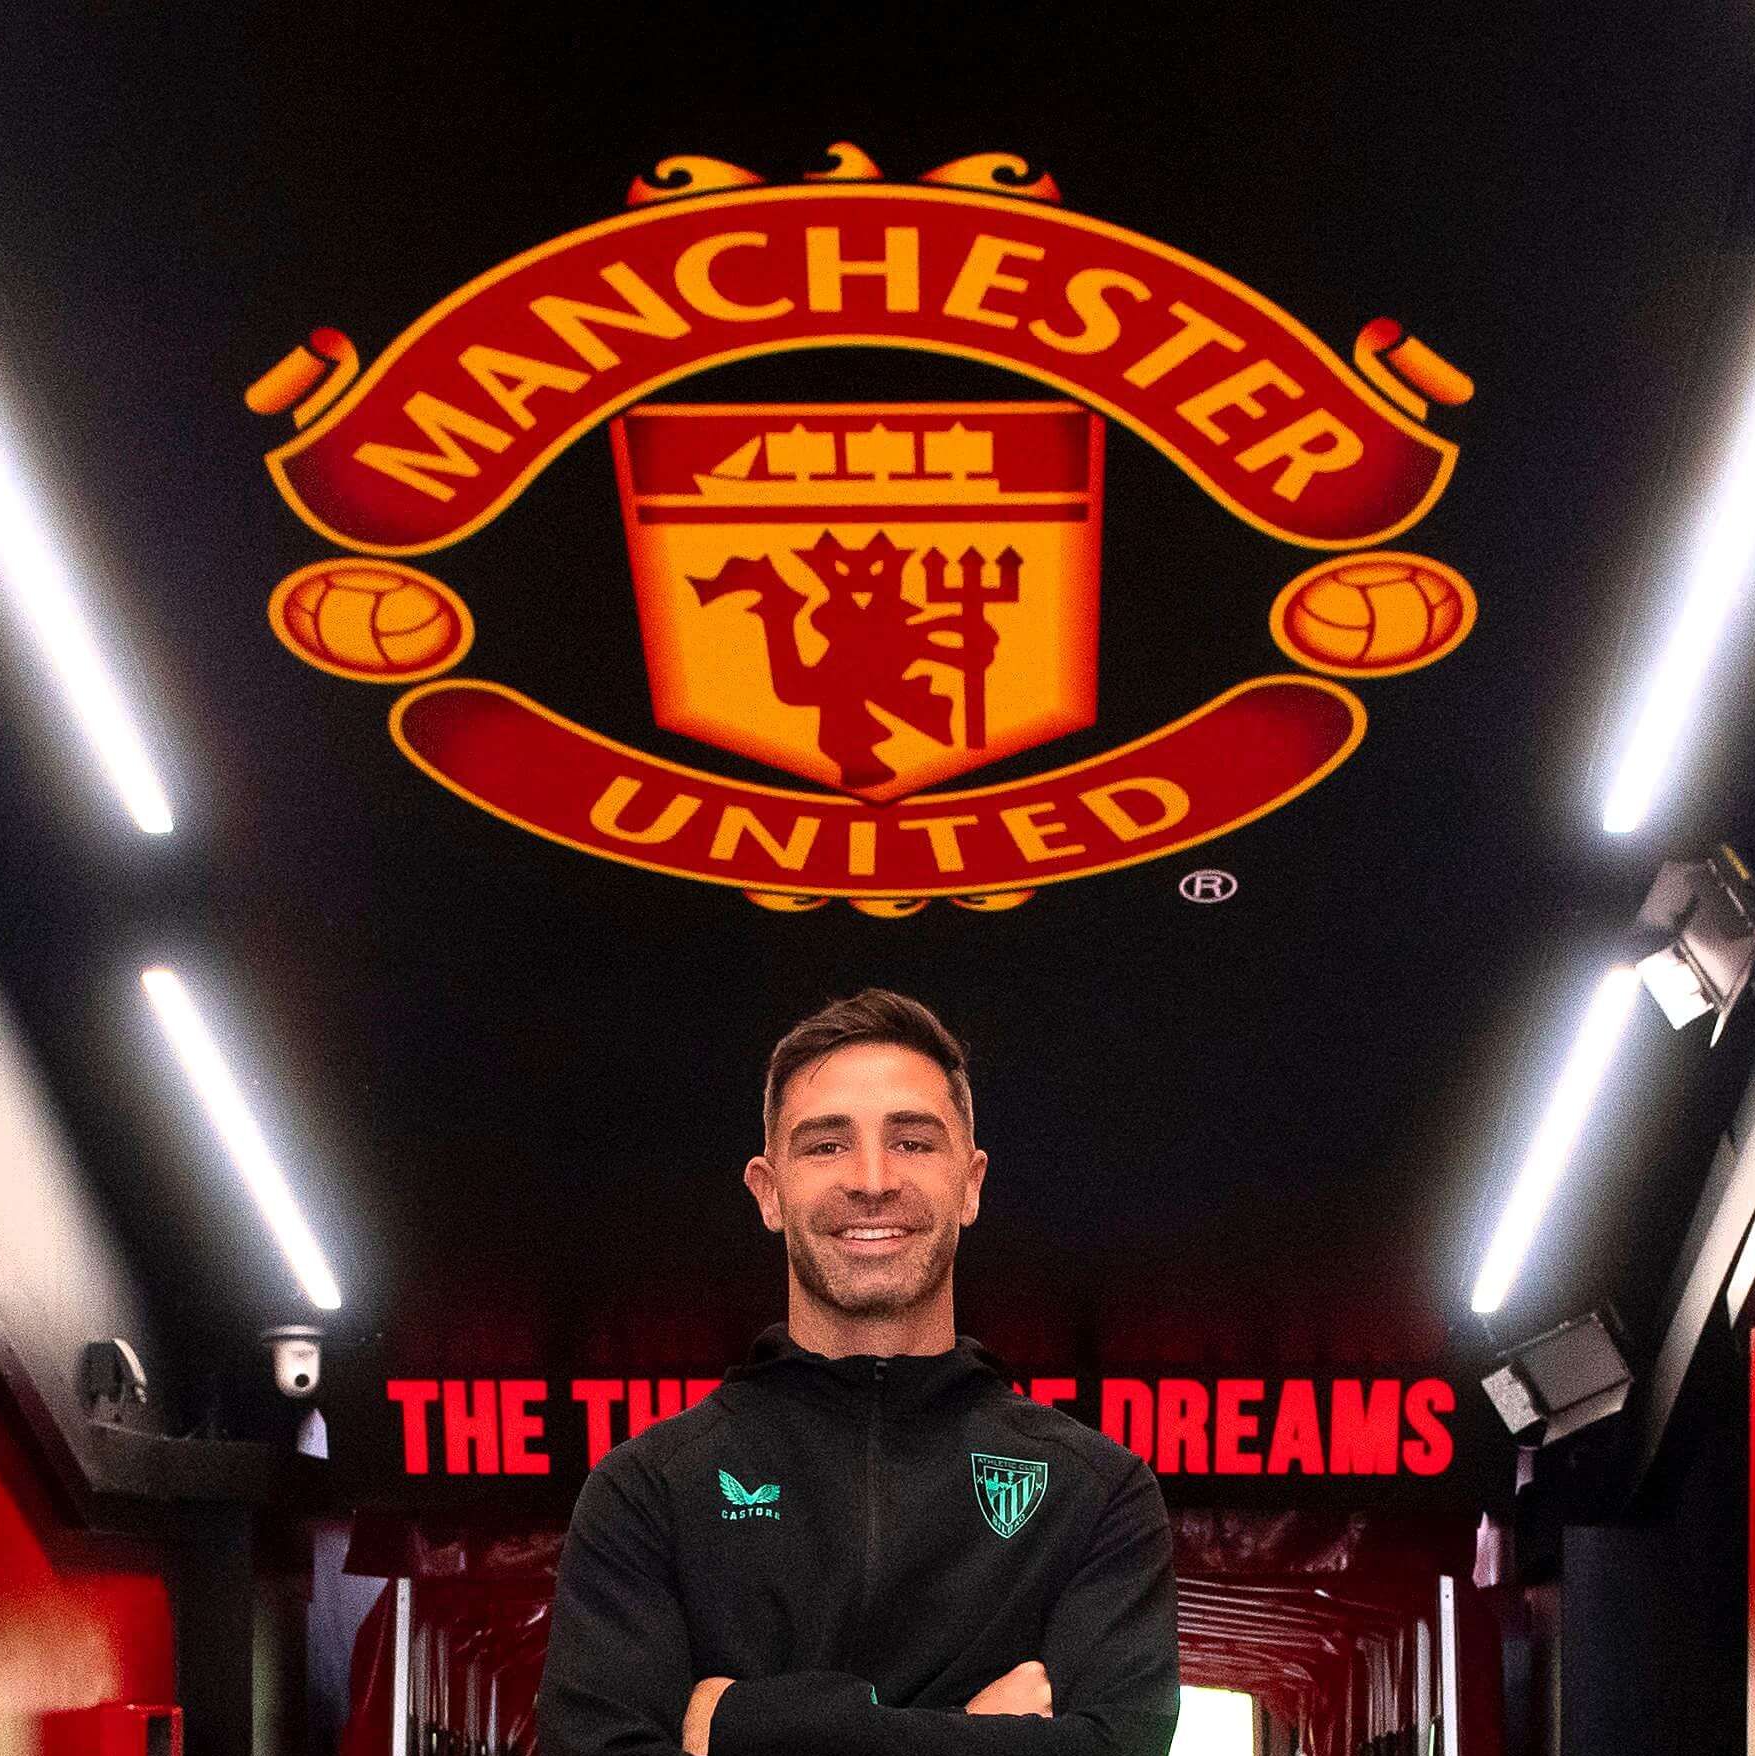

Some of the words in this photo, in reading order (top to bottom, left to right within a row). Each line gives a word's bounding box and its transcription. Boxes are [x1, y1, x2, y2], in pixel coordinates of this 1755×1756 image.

[352, 226, 1366, 504] MANCHESTER
[587, 774, 1192, 875] UNITED
[387, 1379, 550, 1475] THE
[1101, 1379, 1455, 1476] DREAMS
[976, 1457, 1017, 1470] ATHLETIC
[1018, 1463, 1043, 1473] CLUB
[720, 1507, 782, 1521] CASTORE
[991, 1512, 1026, 1535] BILBAO
